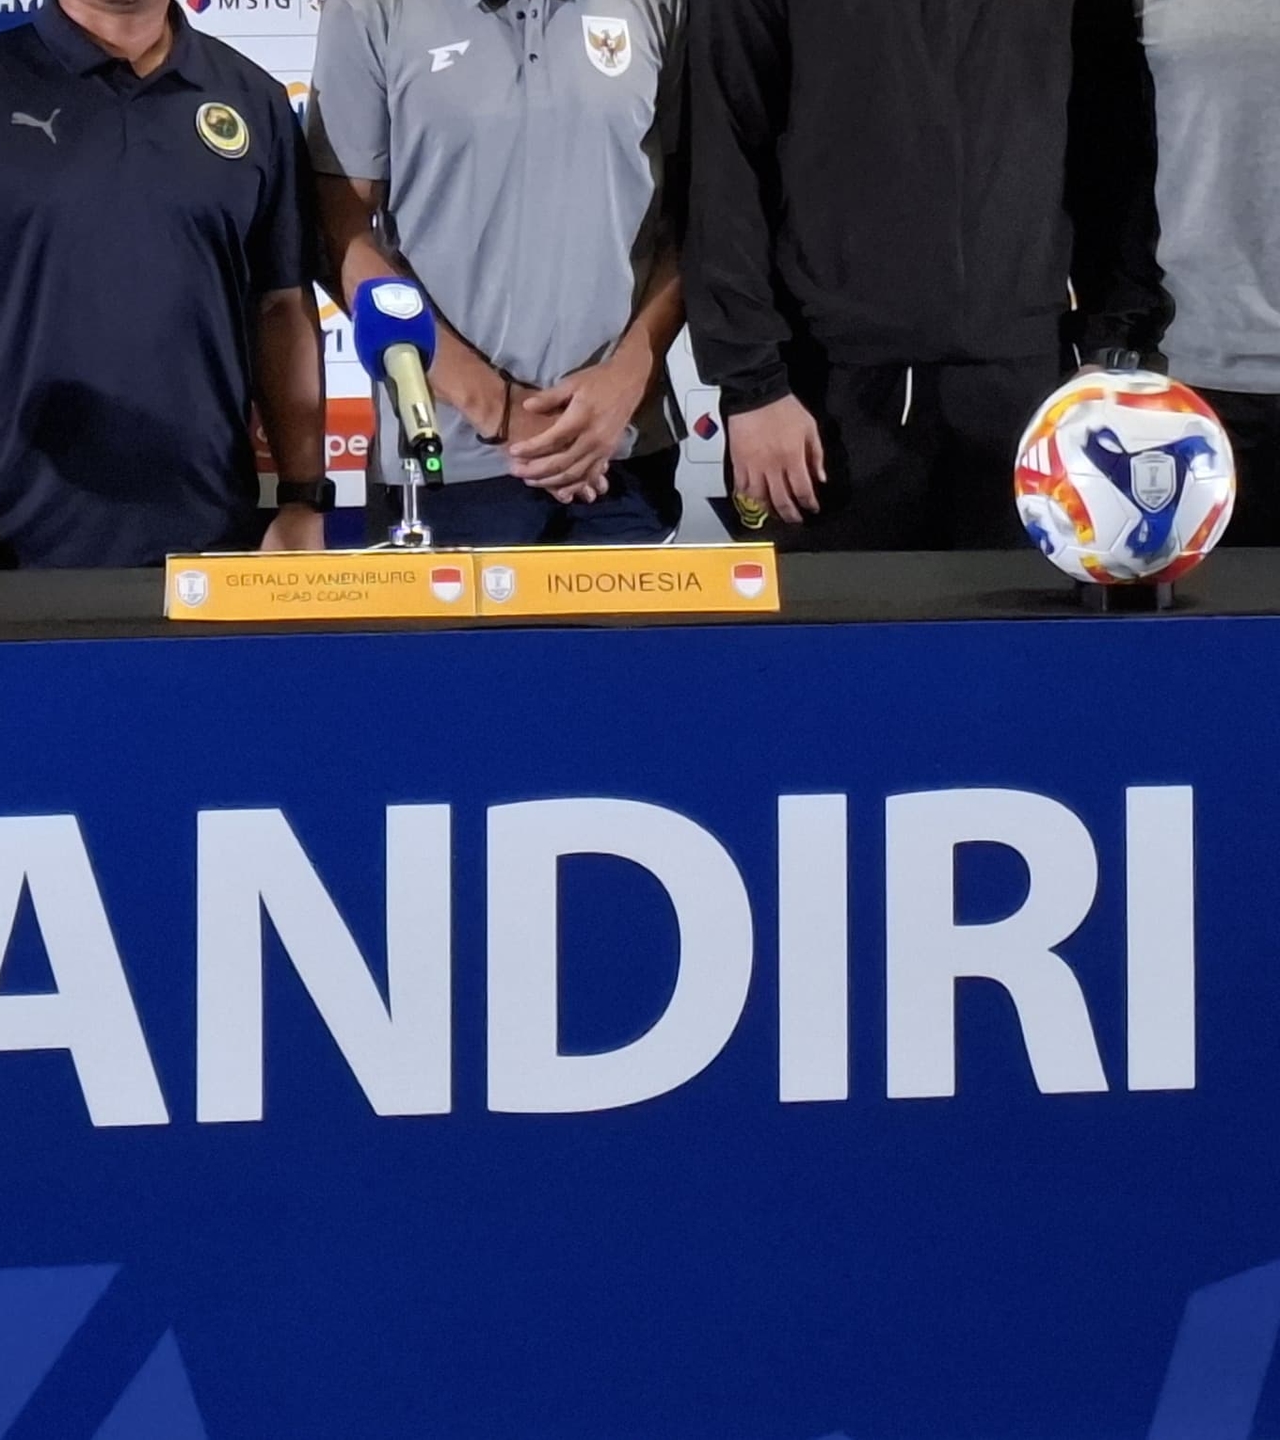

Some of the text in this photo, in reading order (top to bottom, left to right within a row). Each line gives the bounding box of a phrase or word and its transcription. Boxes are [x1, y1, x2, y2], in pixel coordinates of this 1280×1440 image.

[226, 571, 416, 586] GERALD VANENBURG
[548, 573, 702, 593] INDONESIA
